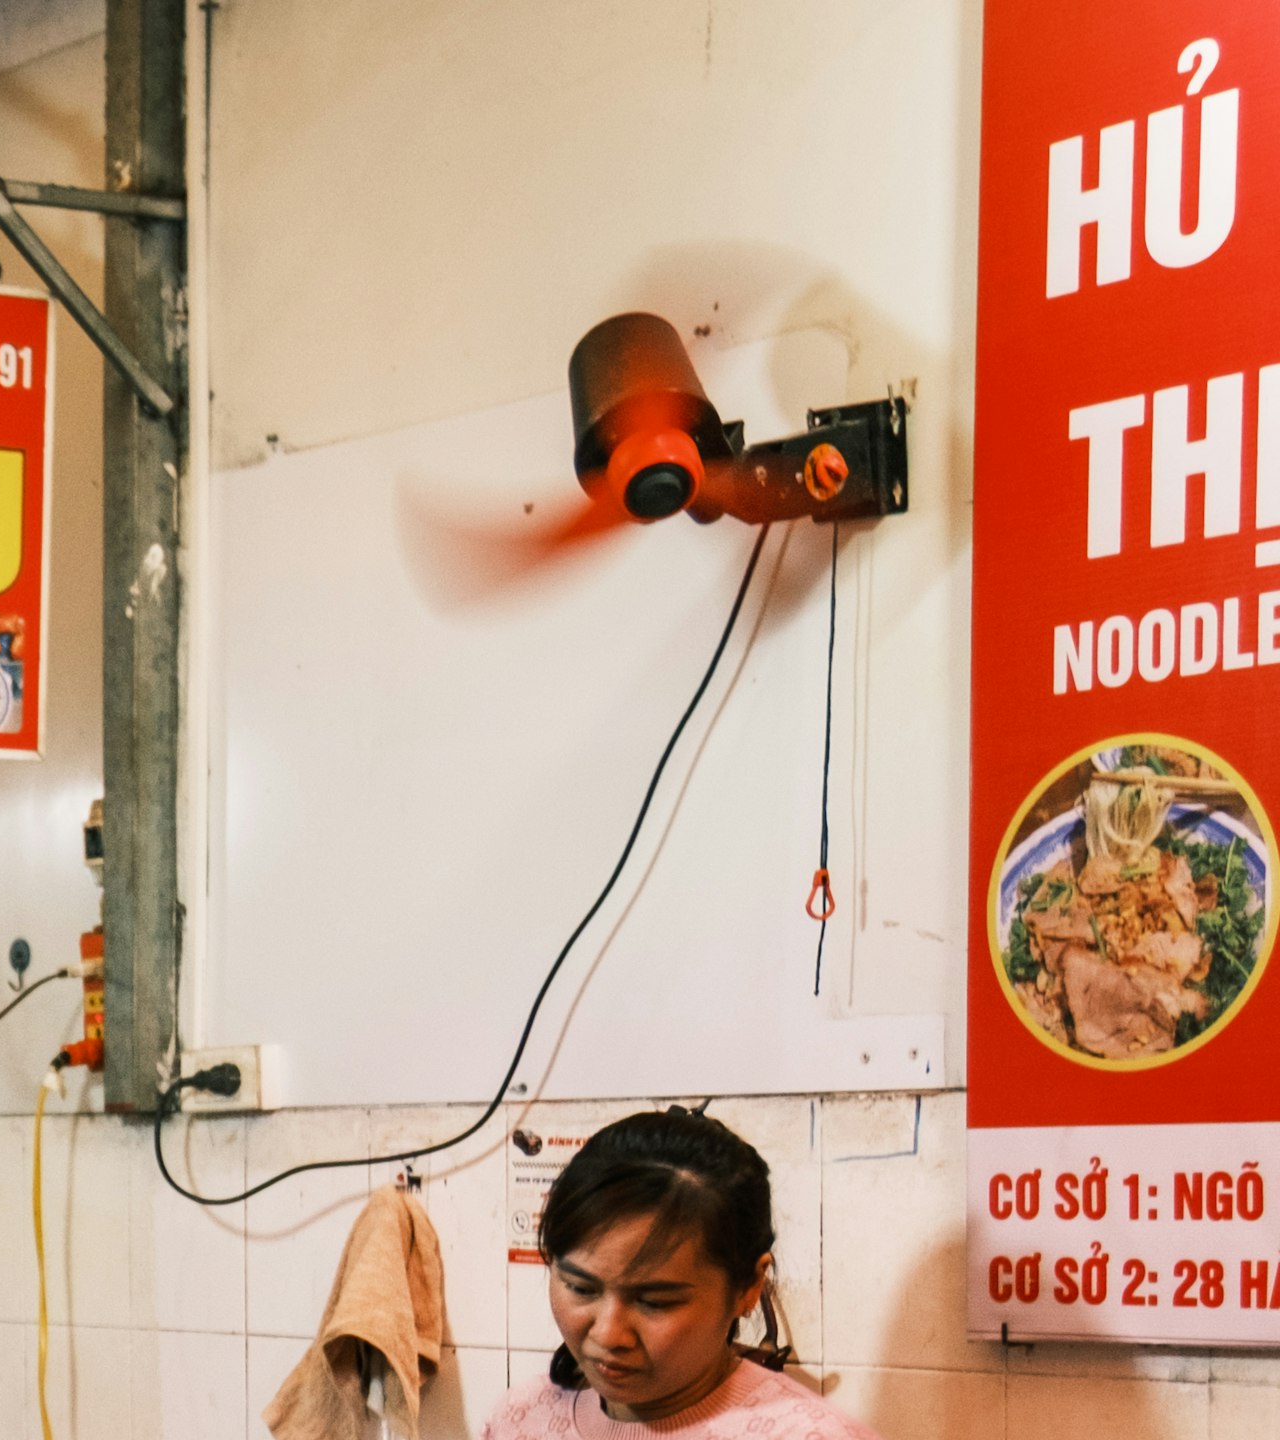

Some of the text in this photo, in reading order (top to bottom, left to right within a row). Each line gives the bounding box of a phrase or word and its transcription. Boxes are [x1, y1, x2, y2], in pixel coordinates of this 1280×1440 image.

[1045, 37, 1240, 299] HỦ
[989, 1156, 1265, 1221] CƠ SỞ 1: NGÕ
[988, 1252, 1042, 1304] CƠ
[1053, 1241, 1110, 1305] SỞ
[1121, 1258, 1159, 1307] 2:
[1172, 1259, 1225, 1309] 28
